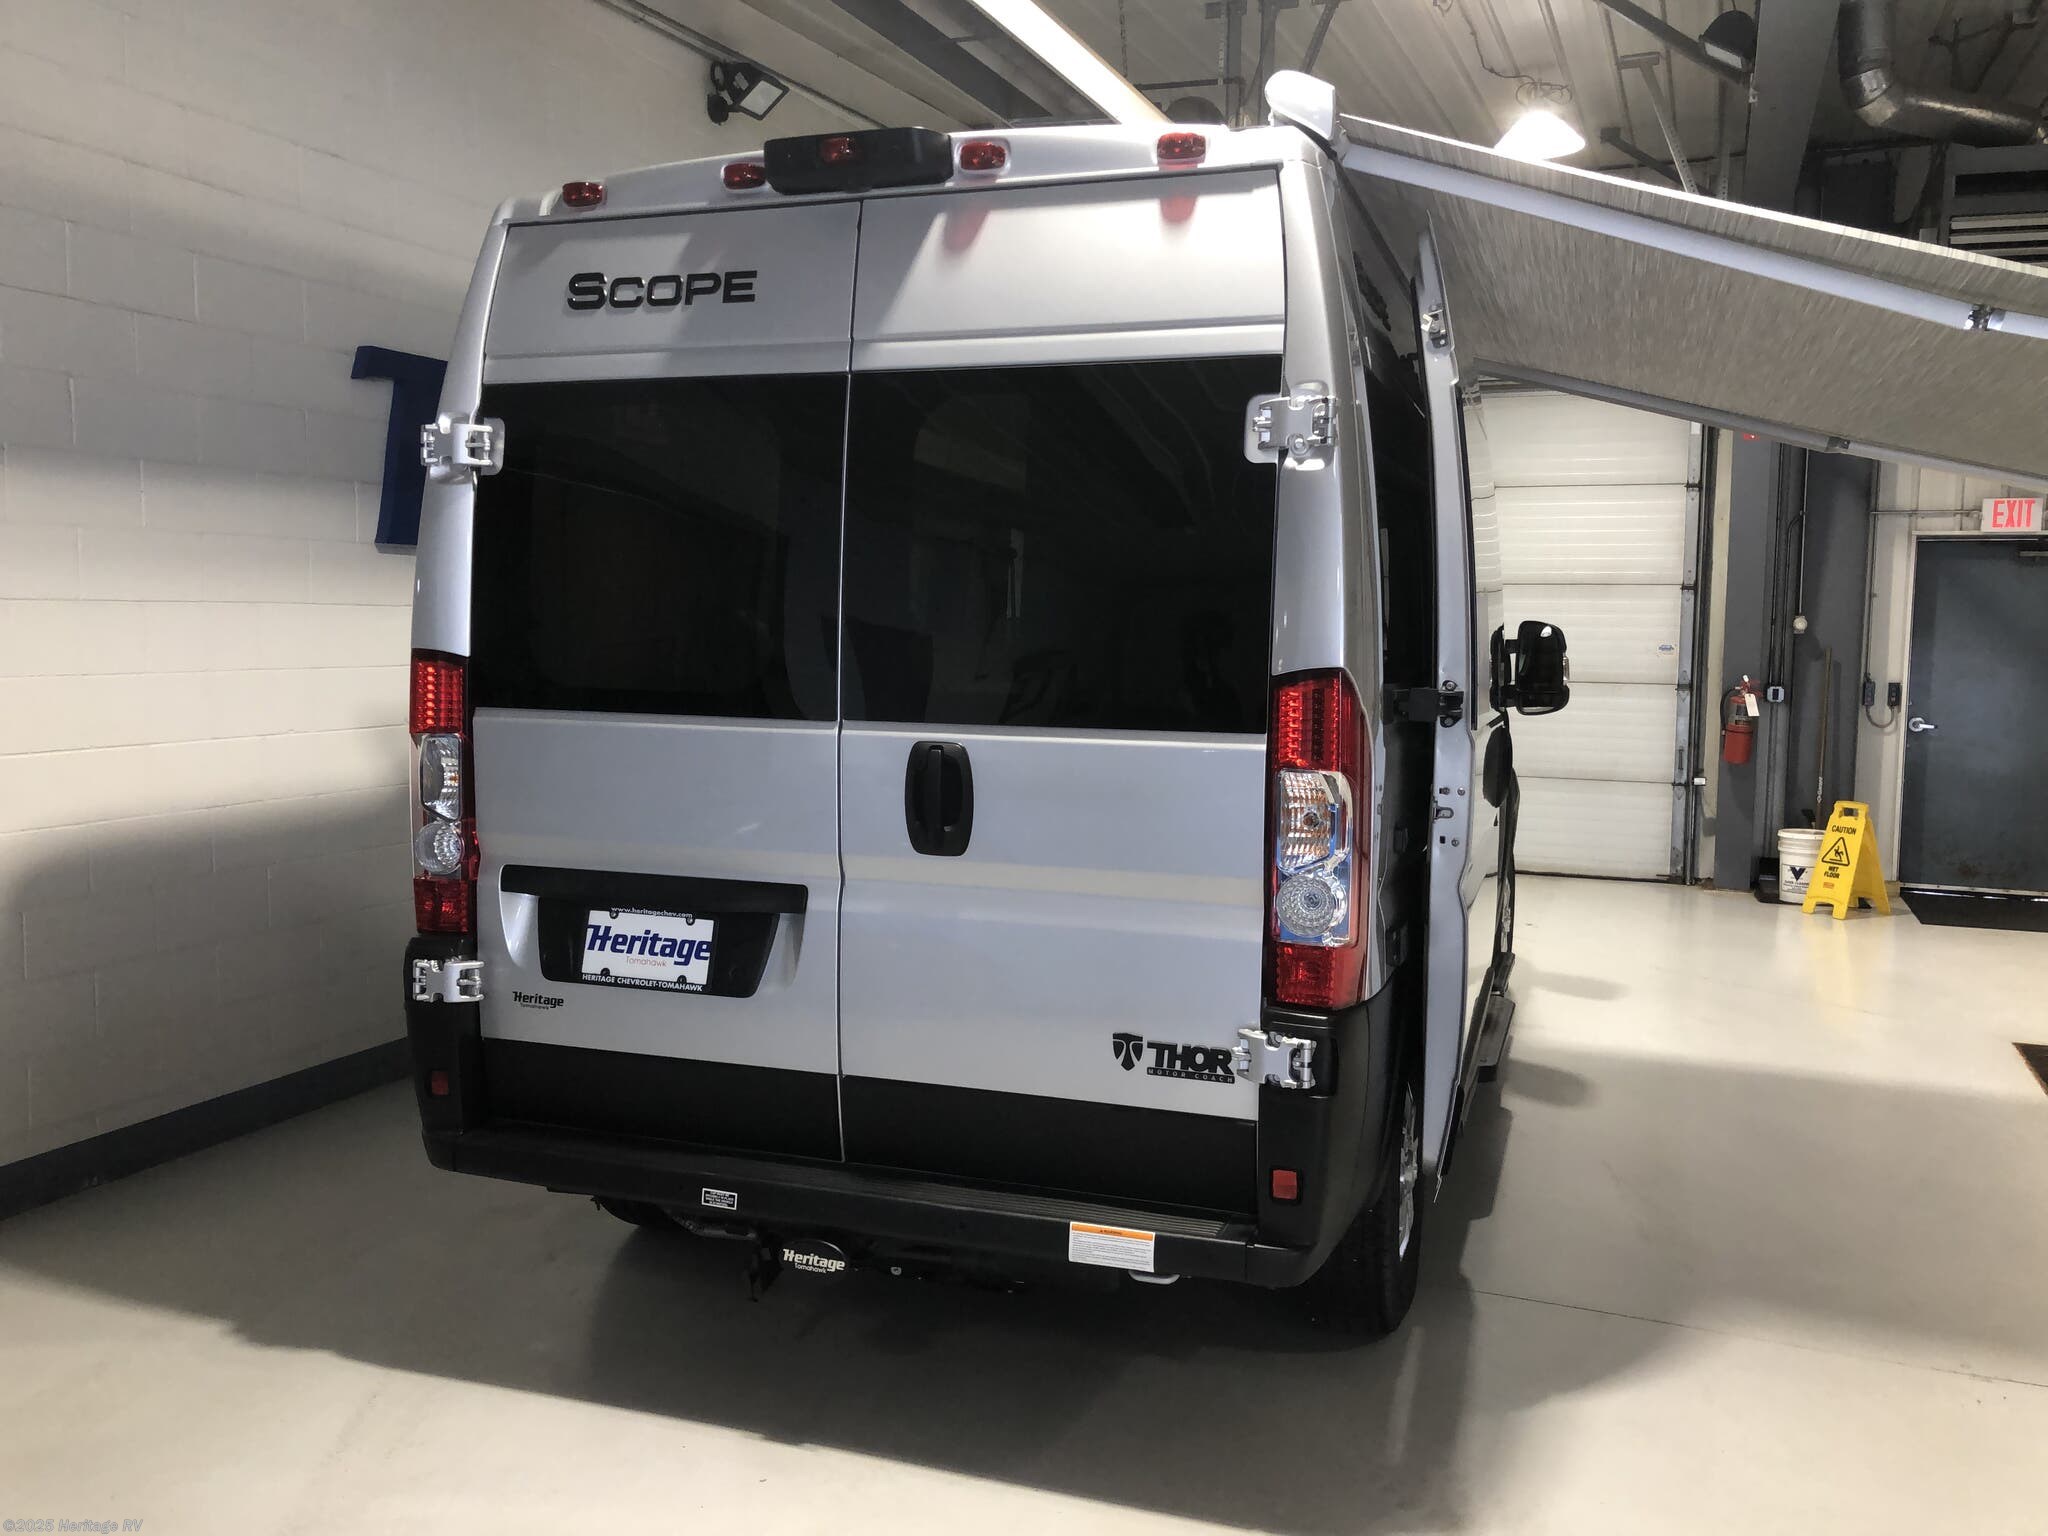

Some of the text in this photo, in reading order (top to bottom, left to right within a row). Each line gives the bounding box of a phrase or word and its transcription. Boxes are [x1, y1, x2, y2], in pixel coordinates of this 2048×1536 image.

[567, 271, 758, 310] SCOPE
[1992, 499, 2036, 528] EXIT
[1831, 824, 1857, 836] CAUTION
[1823, 871, 1840, 879] FLOOR
[611, 906, 693, 919] www.heritagechev.com
[587, 924, 712, 966] Heritage
[626, 956, 667, 968] Tomahawk
[582, 973, 703, 992] HERITAGE CHEVROLET-TOMAHAWK
[512, 991, 564, 1009] Heritage
[1147, 1041, 1234, 1075] THOR
[1148, 1068, 1233, 1083] MOTOR COACH
[783, 1248, 845, 1272] Heritage
